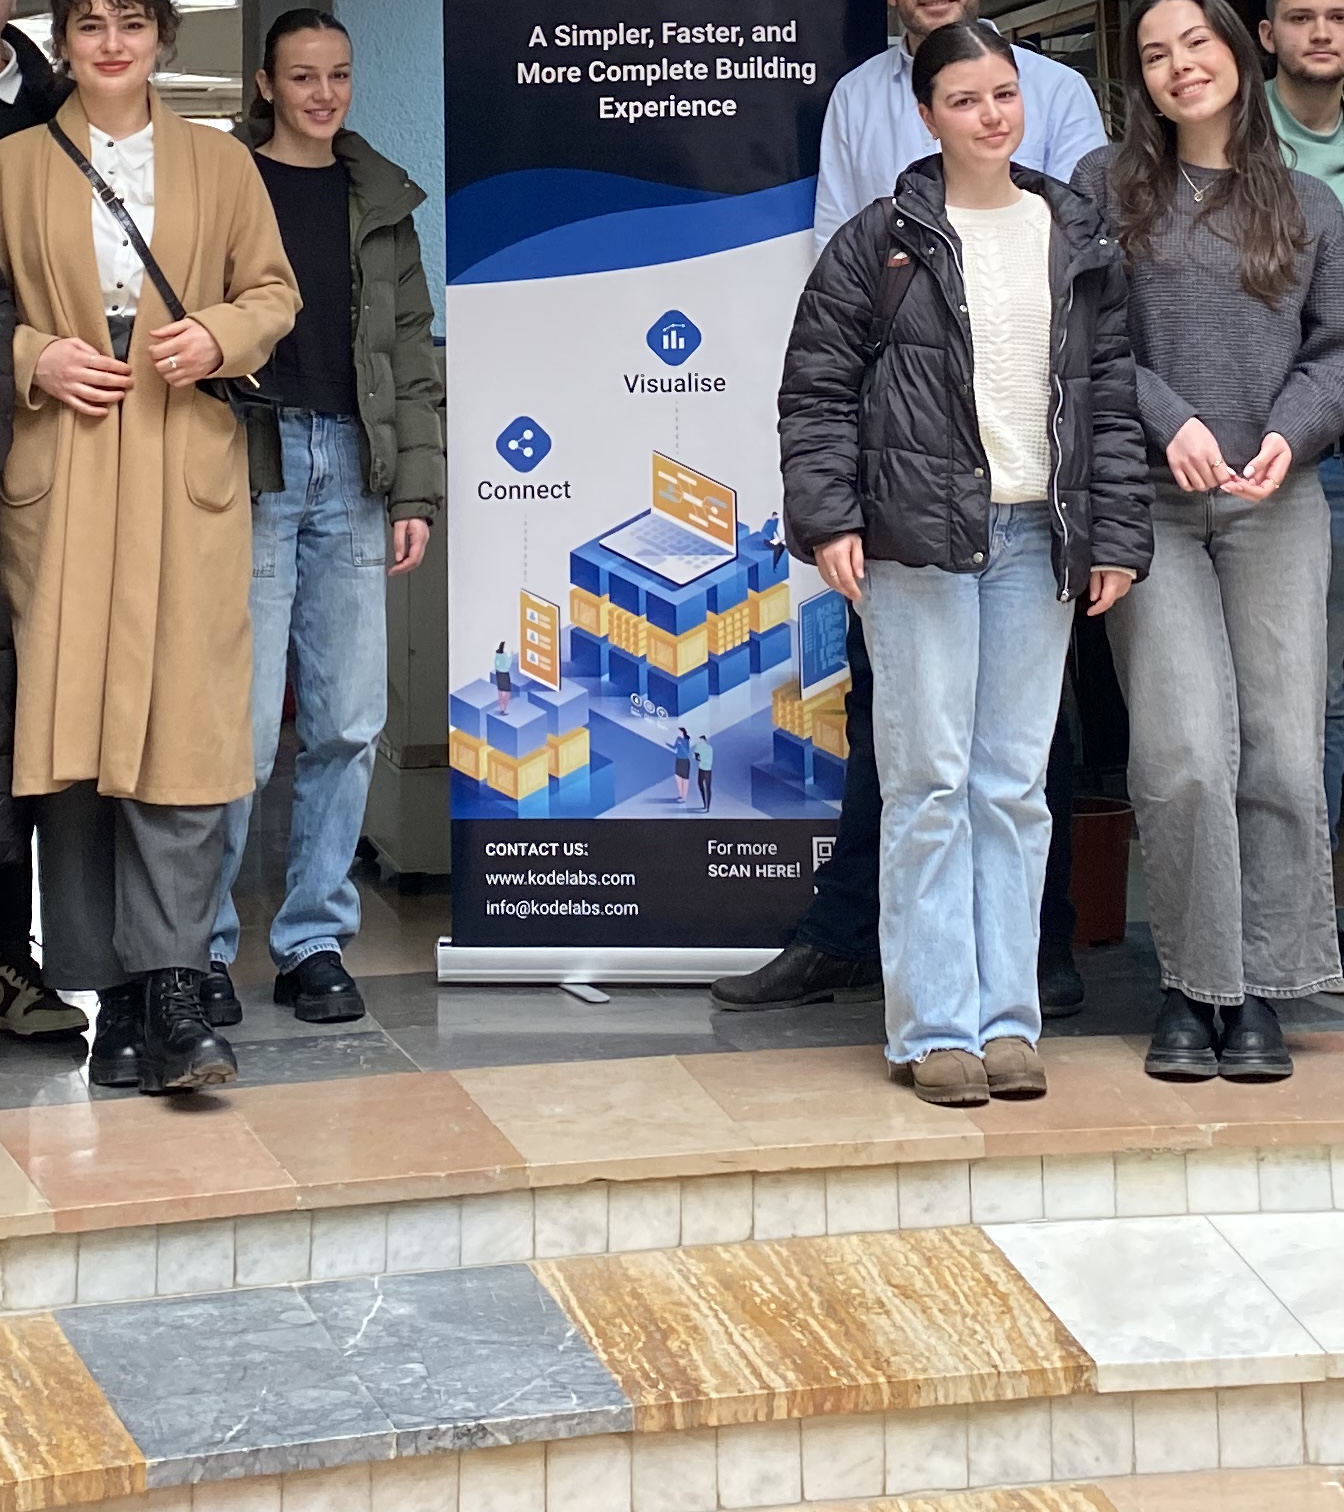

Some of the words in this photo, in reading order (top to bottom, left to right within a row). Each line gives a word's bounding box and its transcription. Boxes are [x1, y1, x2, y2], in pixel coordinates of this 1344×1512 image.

[528, 26, 547, 48] A
[554, 23, 655, 51] Simpler,
[662, 22, 744, 47] Faster,
[752, 21, 797, 43] and
[517, 62, 581, 84] More
[589, 59, 708, 86] Complete
[716, 57, 817, 85] Building
[600, 95, 737, 123] Experience
[623, 372, 727, 394] Visualise
[477, 480, 571, 500] Connect
[485, 842, 559, 857] CONTACT
[563, 842, 589, 857] US:
[708, 840, 733, 856] For
[737, 843, 778, 856] more
[485, 869, 636, 887] www.kodelabs.com
[708, 864, 751, 878] SCAN
[755, 862, 800, 878] HERE!
[486, 899, 639, 919] info@kodelabs.com
